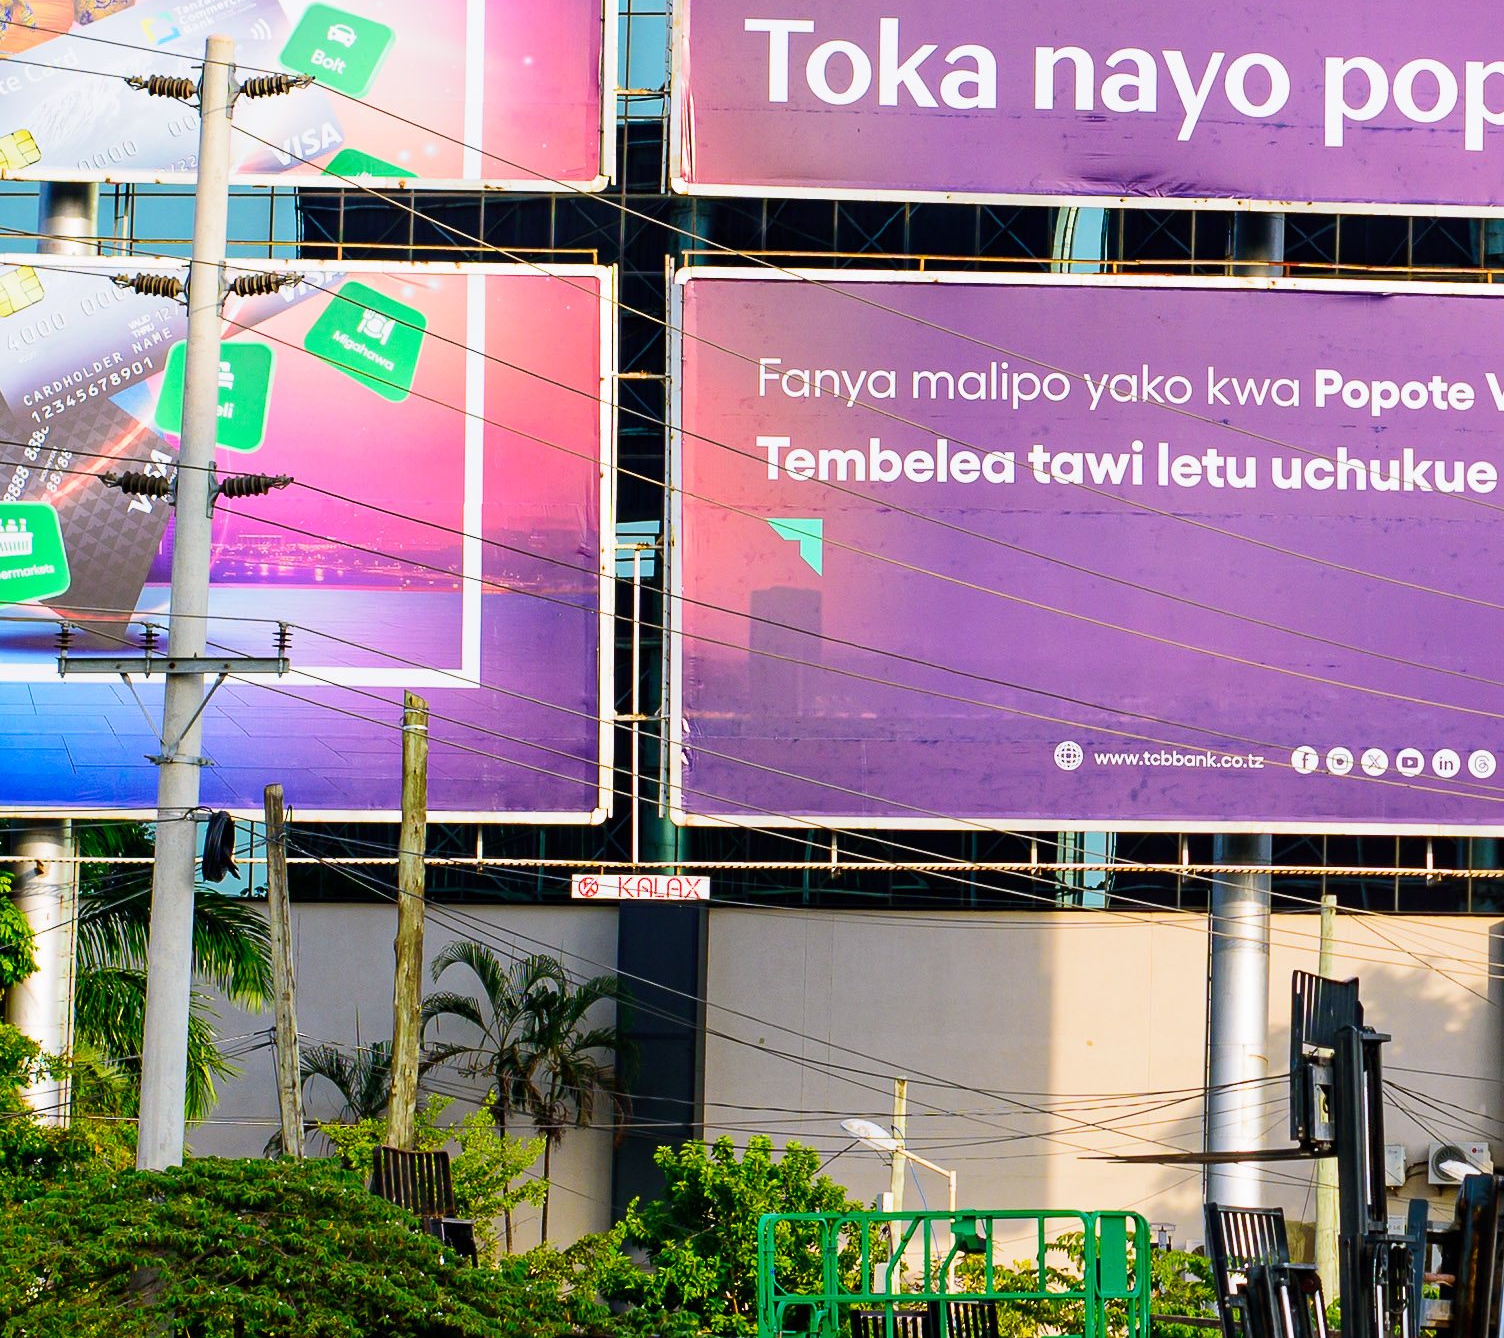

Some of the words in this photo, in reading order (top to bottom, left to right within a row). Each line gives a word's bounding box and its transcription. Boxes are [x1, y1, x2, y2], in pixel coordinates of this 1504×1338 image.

[23, 47, 79, 84] Card
[310, 48, 346, 76] Bolt
[744, 17, 998, 109] Toka
[1035, 45, 1292, 142] nayo
[267, 121, 344, 167] VISA
[5, 309, 69, 351] 4000
[331, 329, 396, 373] Migahawa
[22, 351, 124, 407] CARDHOLDER
[131, 326, 174, 355] NAME
[758, 357, 897, 408] Fanya
[912, 360, 1071, 411] malipo
[1088, 363, 1193, 411] yako
[1207, 366, 1300, 408] kwa
[1314, 368, 1476, 416] Popote
[31, 355, 154, 425] 12345678901
[755, 436, 1015, 487] Tembelea
[1028, 440, 1144, 488] tawi
[1157, 443, 1257, 491] letu
[1271, 446, 1498, 495] uchukue
[1094, 748, 1265, 770] www.tcbbank.co.tz
[618, 876, 702, 901] KALAX
